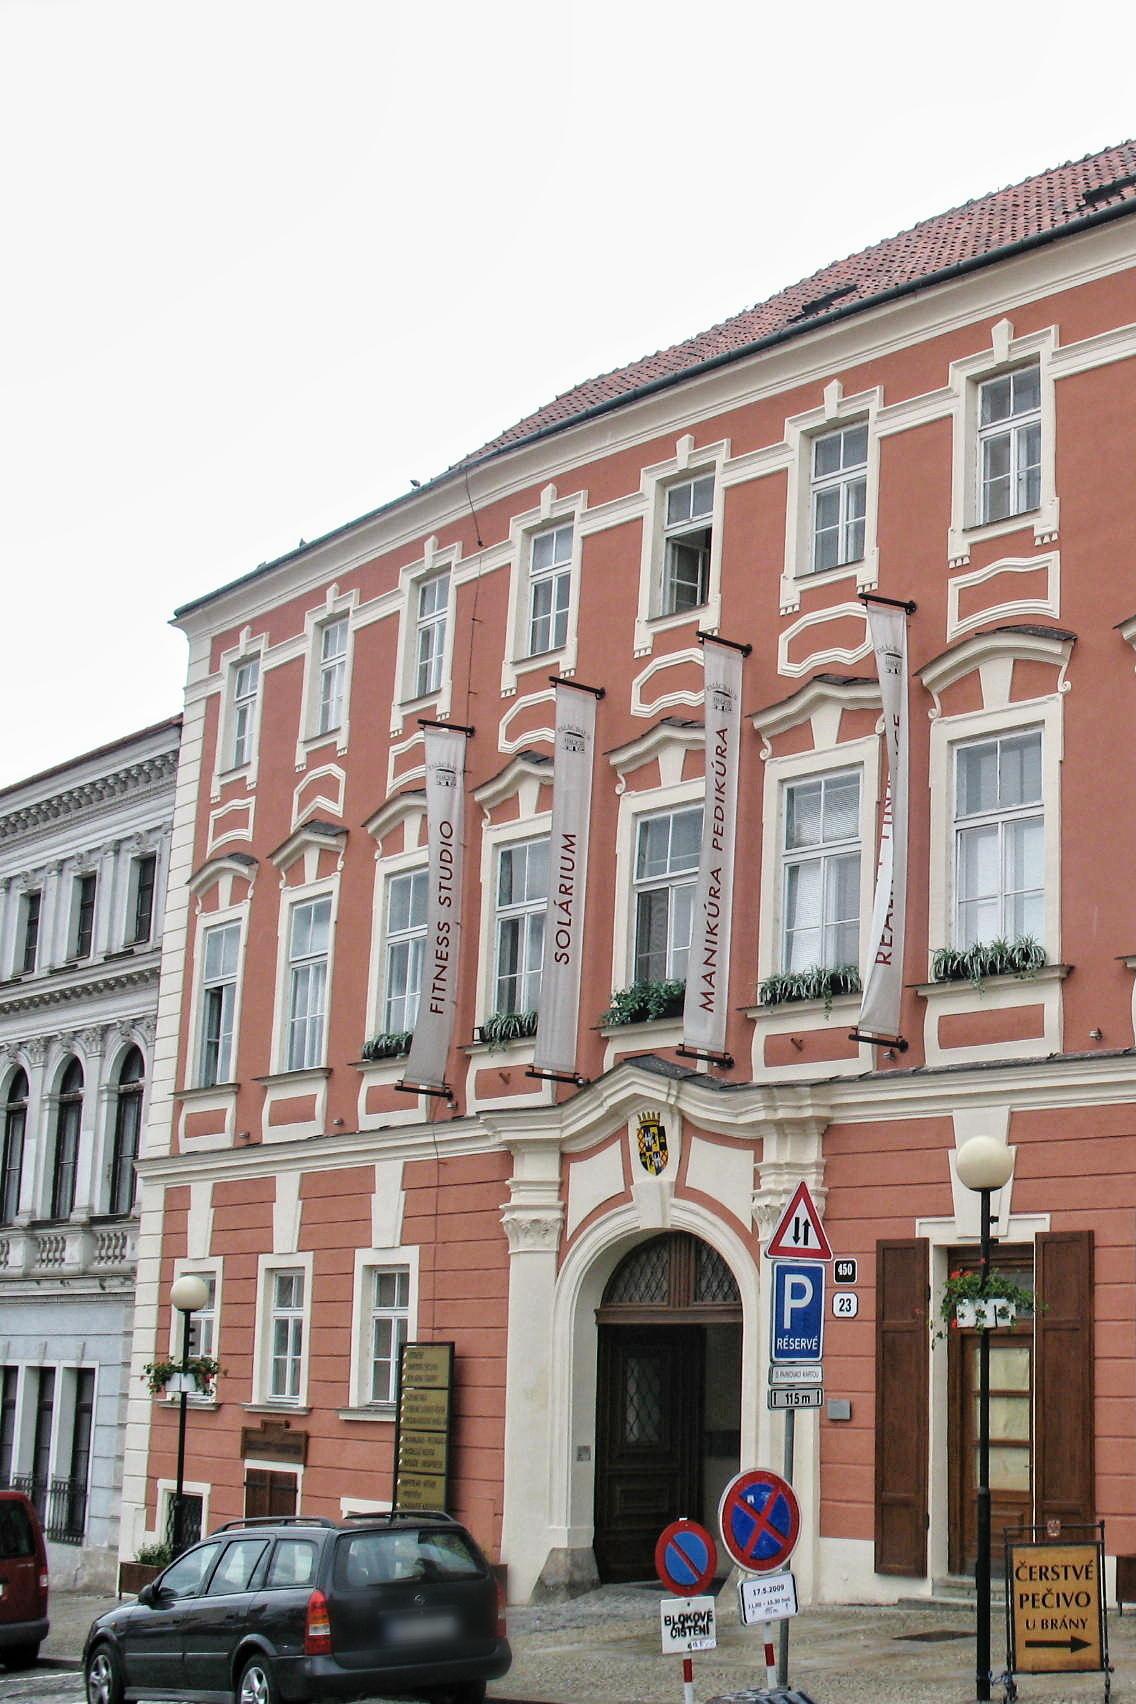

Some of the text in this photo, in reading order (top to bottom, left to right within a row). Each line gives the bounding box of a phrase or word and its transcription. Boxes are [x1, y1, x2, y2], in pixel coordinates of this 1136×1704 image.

[699, 867, 722, 1013] MANIKÚRA
[711, 727, 728, 852] PEDIKÚRA
[554, 833, 577, 965] SOLÁRIUM
[430, 820, 455, 1015] FITNESS STUDIO
[837, 1263, 853, 1276] 450
[783, 1273, 814, 1329] P
[839, 1298, 852, 1312] 23
[776, 1334, 818, 1350] RÉSERVÉ
[785, 1392, 811, 1405] 115 m
[1015, 1560, 1094, 1581] ČERSTVÉ
[1020, 1588, 1091, 1609] PEČIVO
[1026, 1615, 1088, 1630] U BRÁNY
